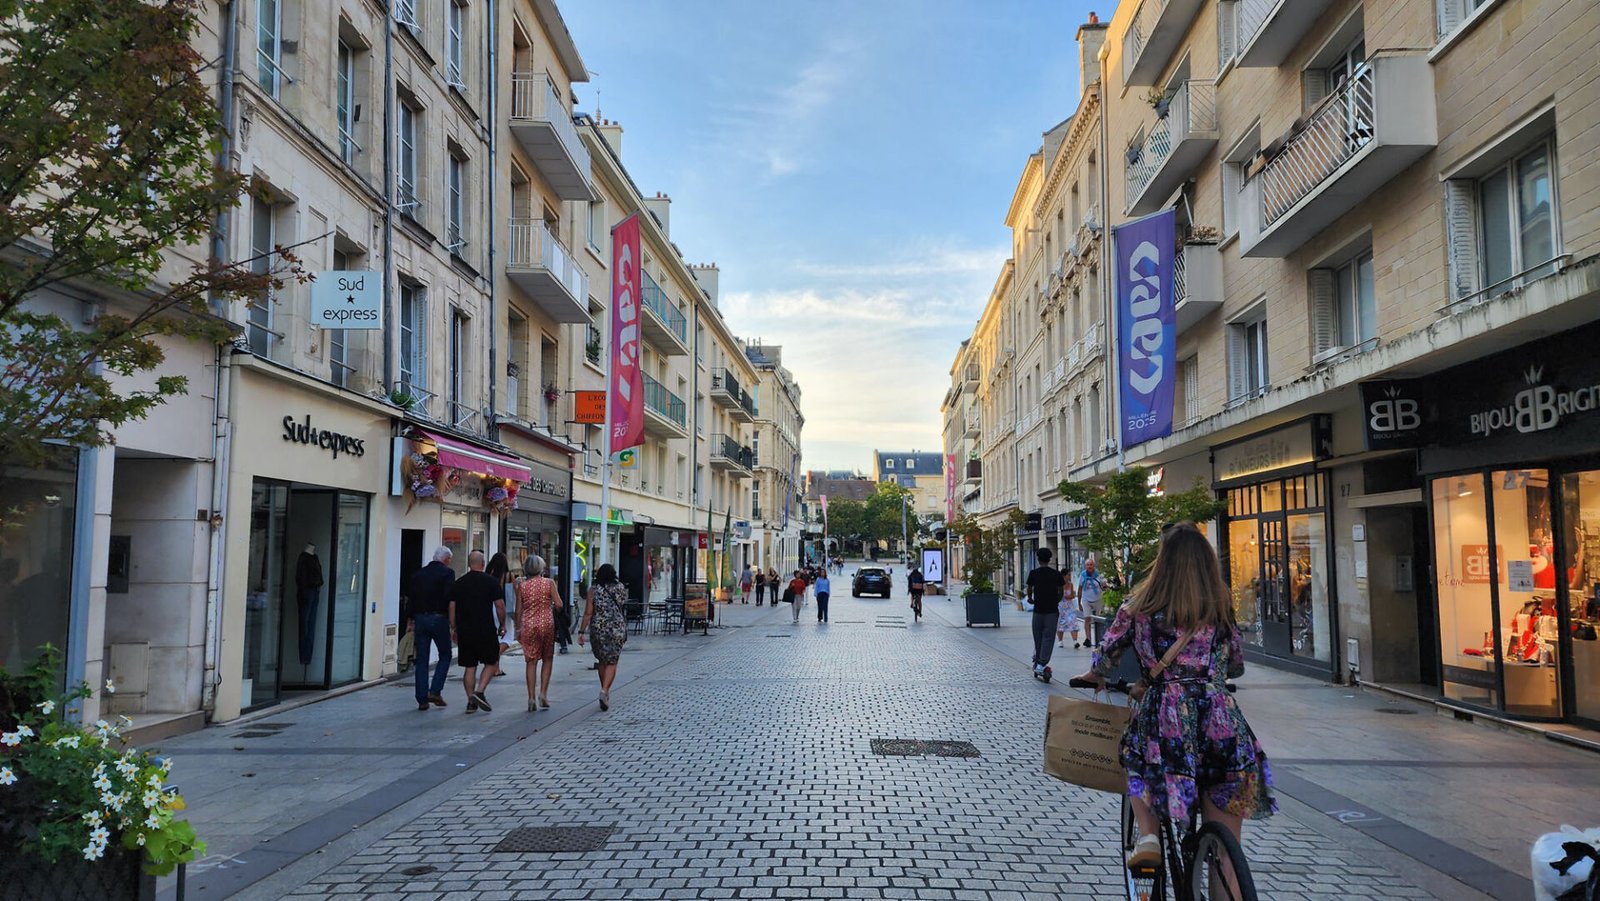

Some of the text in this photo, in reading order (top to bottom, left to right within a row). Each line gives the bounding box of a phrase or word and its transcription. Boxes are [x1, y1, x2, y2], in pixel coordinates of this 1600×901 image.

[337, 275, 364, 291] Sud
[323, 309, 378, 325] express
[1470, 405, 1515, 437] BIJOU
[282, 414, 366, 460] Sud express
